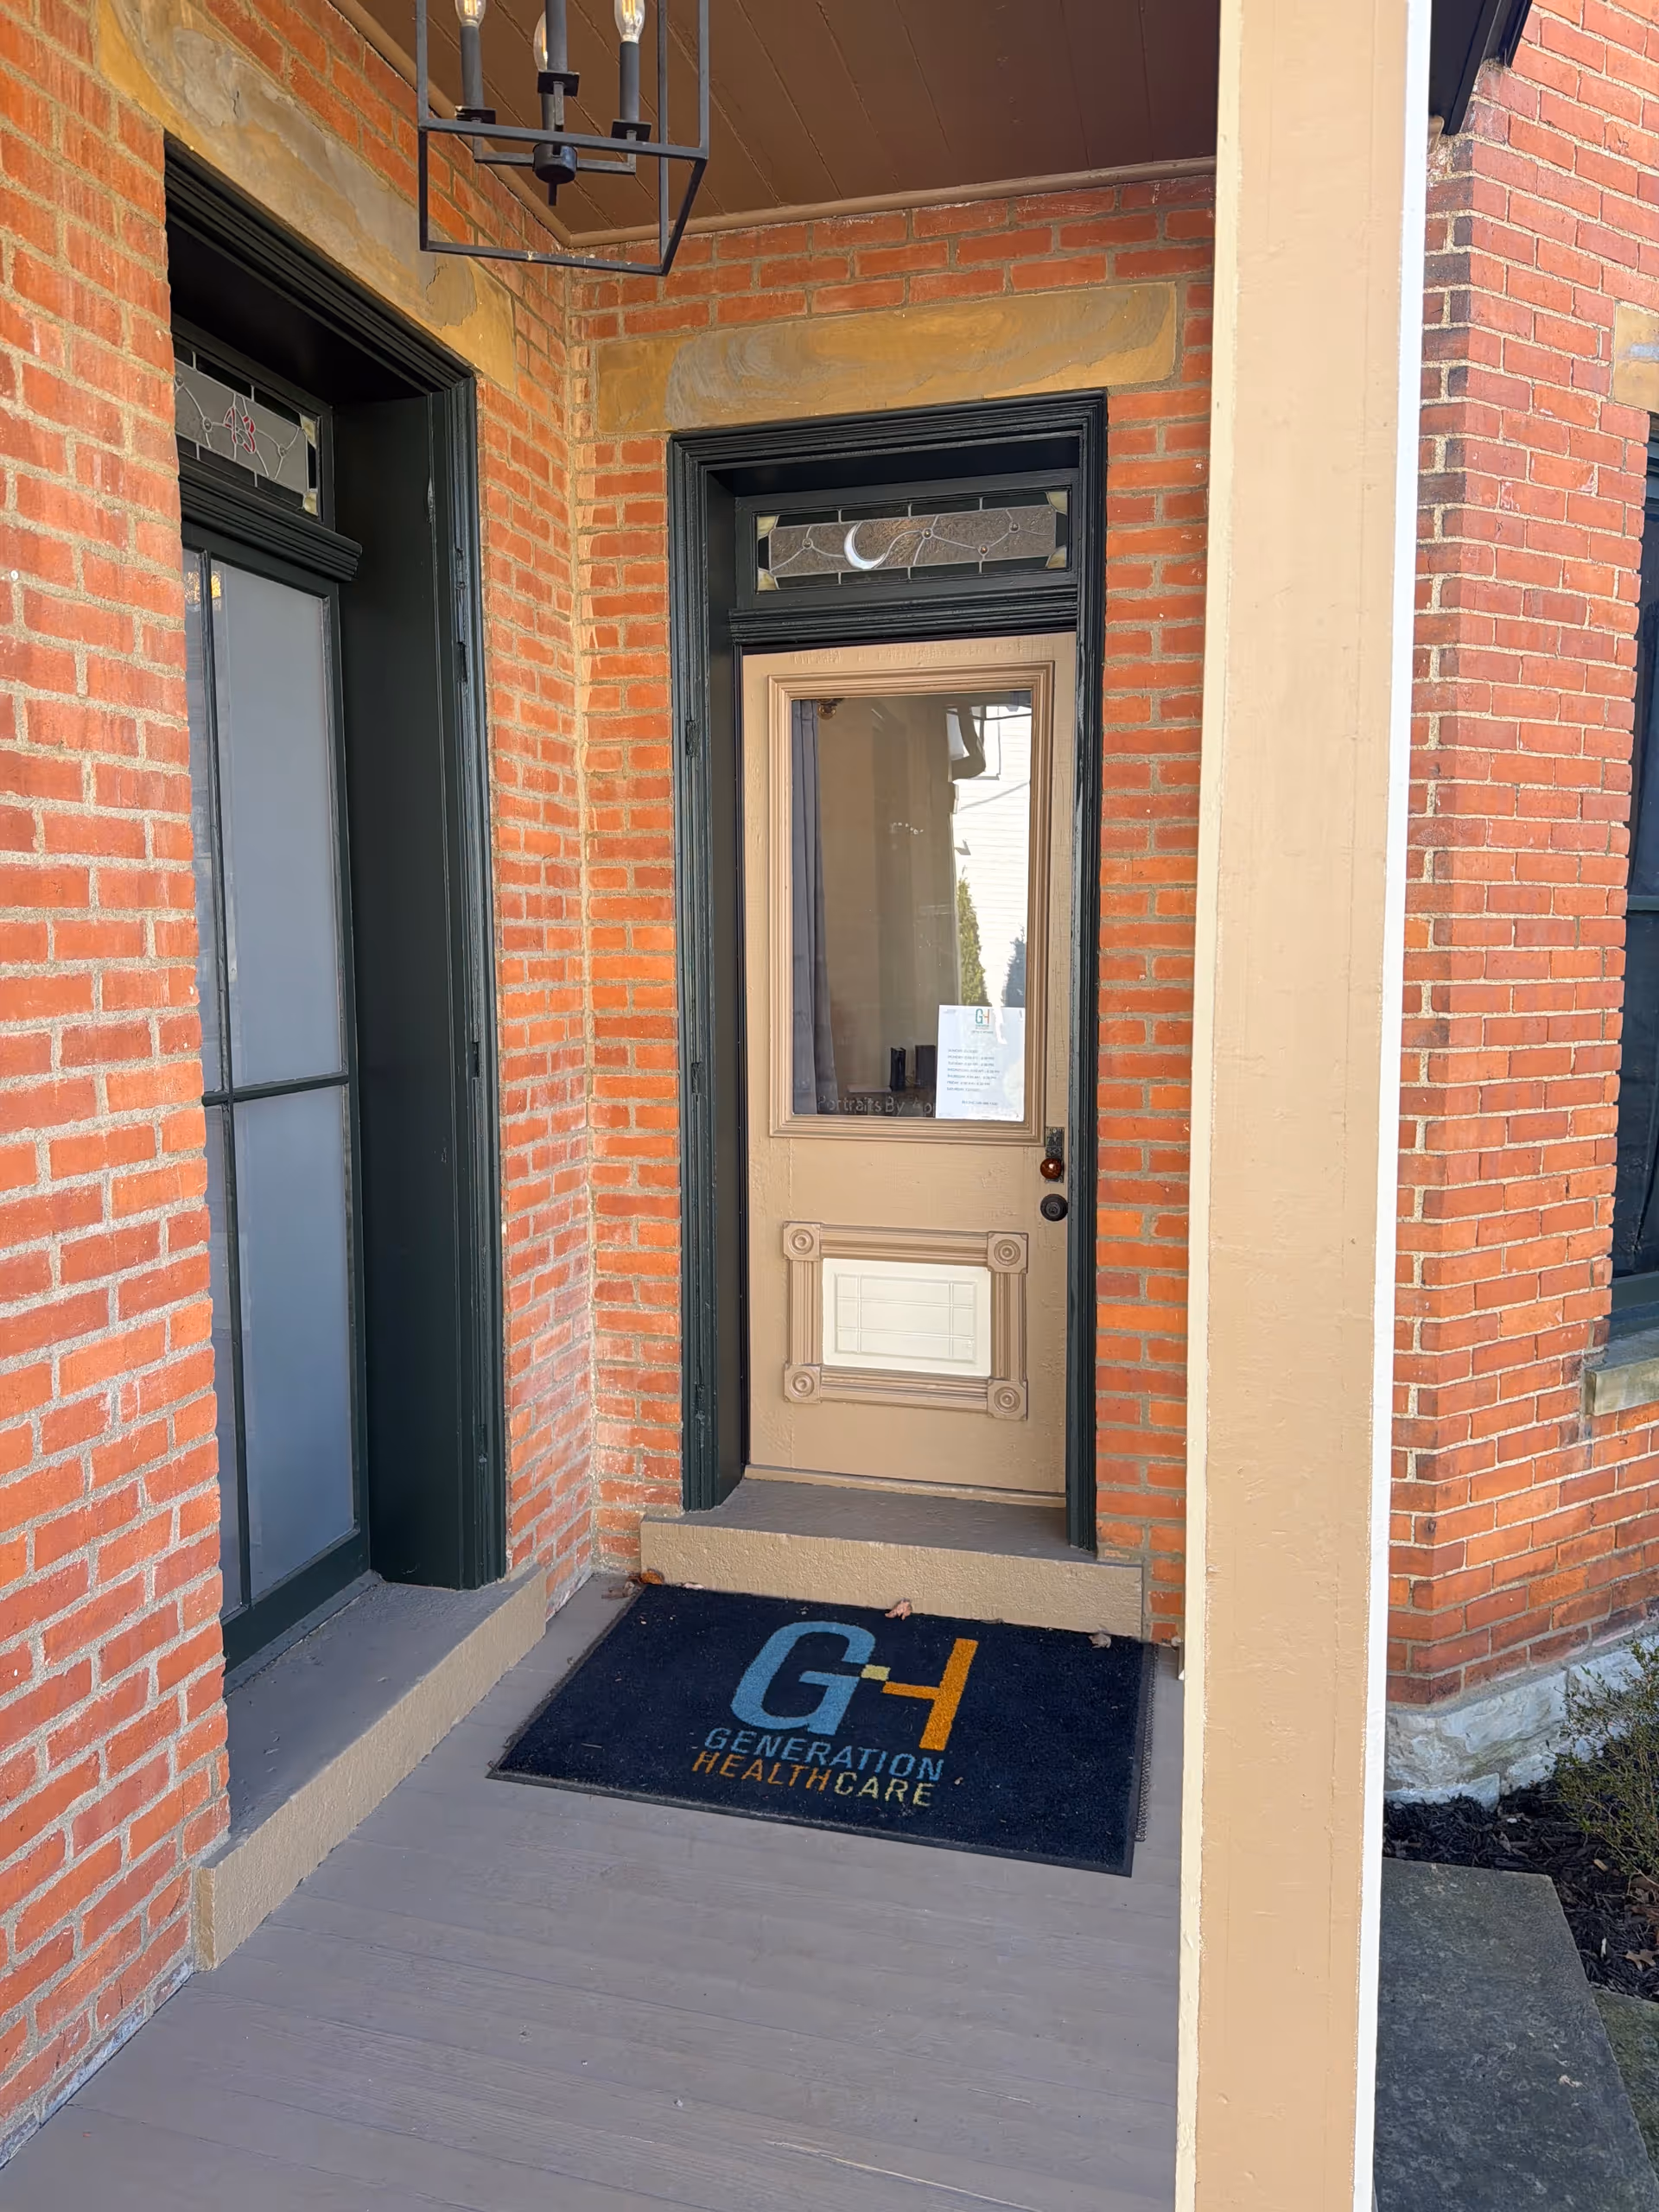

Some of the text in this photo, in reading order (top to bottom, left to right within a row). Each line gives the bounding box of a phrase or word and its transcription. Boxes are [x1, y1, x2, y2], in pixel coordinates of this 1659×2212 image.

[223, 406, 257, 454] 43
[976, 1008, 990, 1025] GH
[817, 1096, 882, 1113] Portraits
[885, 1096, 906, 1117] By
[730, 1620, 979, 1751] GH
[691, 1750, 936, 1808] HEALTHCARE
[704, 1727, 944, 1782] GENERATION
